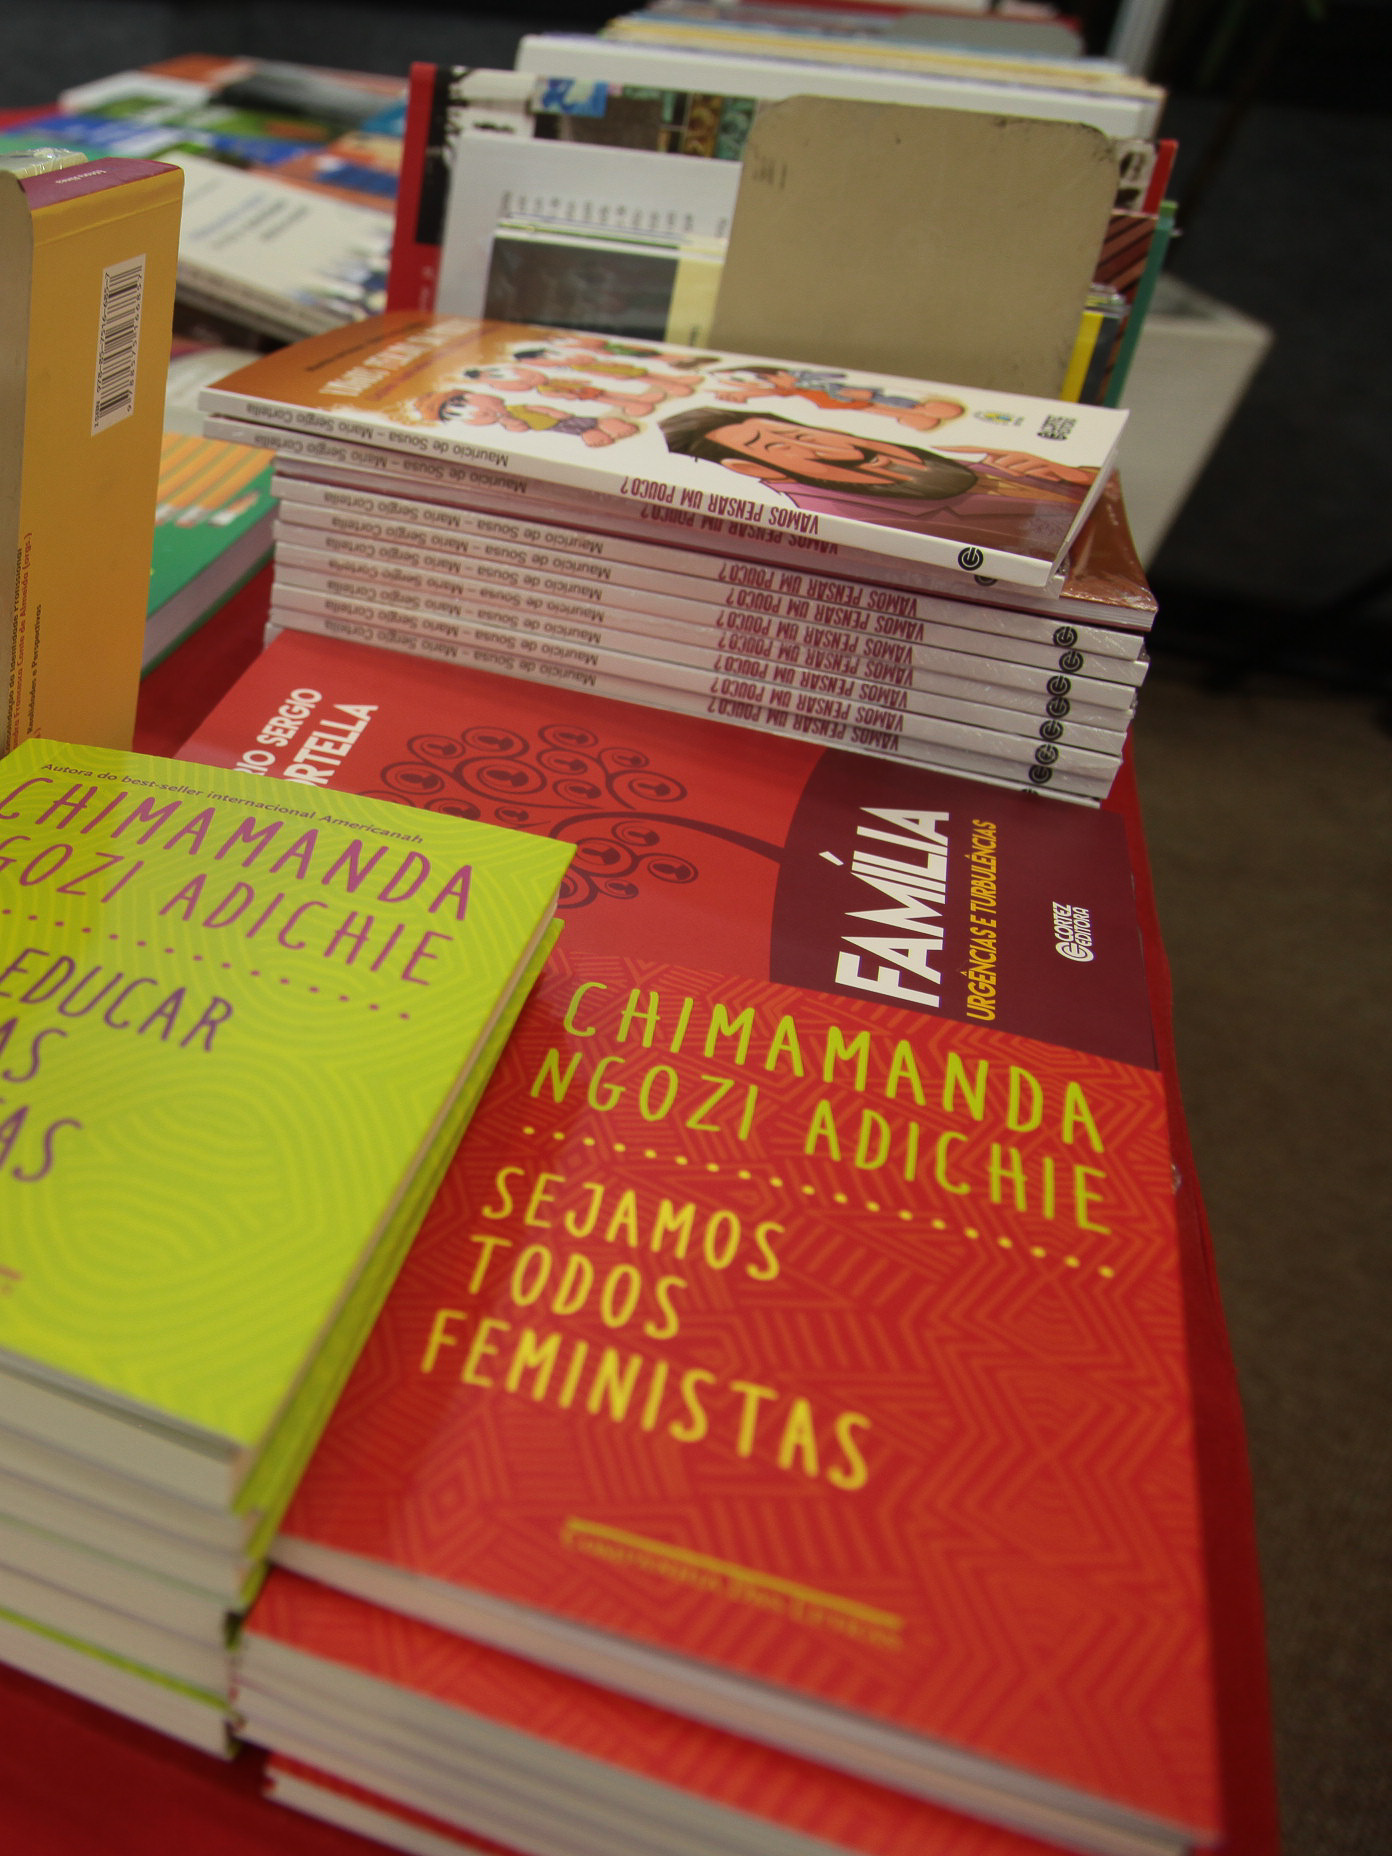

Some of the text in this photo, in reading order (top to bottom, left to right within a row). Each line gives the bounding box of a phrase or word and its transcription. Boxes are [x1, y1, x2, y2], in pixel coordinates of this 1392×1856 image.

[245, 401, 509, 467] Mauricio de Sousa Mario Sergio Cortella
[252, 431, 527, 494] Mauricio de Sousa Mario Sergio Cortella
[322, 490, 604, 554] Mauricio de Sousa Mario Sergio Cortella
[615, 473, 821, 535] VAMOS PENSAR UM POUCO?
[323, 535, 603, 601] Mauricio de Sousa Mario Sergio Cortella
[330, 515, 611, 580] Mauricio de Sousa Mario Sergio Cortella
[325, 578, 601, 644] Mauricio de Sousa Mario Sergio Cortella
[327, 557, 605, 623] Mauricio de Sousa Mario Sergio Cortella
[717, 562, 918, 617] VAMOS PENSAR UM POUCO?
[725, 586, 925, 641] VAMOS PENSAR UM POUCO?
[322, 618, 597, 685] Mauricio de Sousa Mario Sergio Cortella
[323, 598, 599, 665] Mauricio de Sousa Mario Sergio Cortella
[715, 609, 914, 665] VAMOS PENSAR UM POUCO?
[717, 630, 914, 686] VAMOS PENSAR UM POUCO?
[709, 675, 904, 732] VAMOS PENSAR UM POUCO?
[712, 653, 909, 708] VAMOS PENSAR UM POUCO?
[256, 688, 322, 747] SERGIO
[283, 703, 379, 787] RTELLA
[705, 695, 900, 751] VAMOS PENSAR UM POUCO?
[41, 762, 425, 844] Autora do best-seller internacional Americanah
[158, 873, 455, 987] ADICHIE
[819, 807, 949, 1008] FAMÍLIA
[961, 819, 996, 1021] URGÊNCIAS E TURBULÊNCIAS
[1053, 901, 1072, 941] CORTEZ
[1073, 907, 1093, 947] EDITORA
[563, 981, 1104, 1153] CHIMAMANDA
[530, 1048, 1111, 1236] NGOZI ADICHIE
[482, 1166, 786, 1282] SEJAMOS
[468, 1235, 688, 1341] TODOS
[420, 1309, 873, 1492] FEMINISTAS
